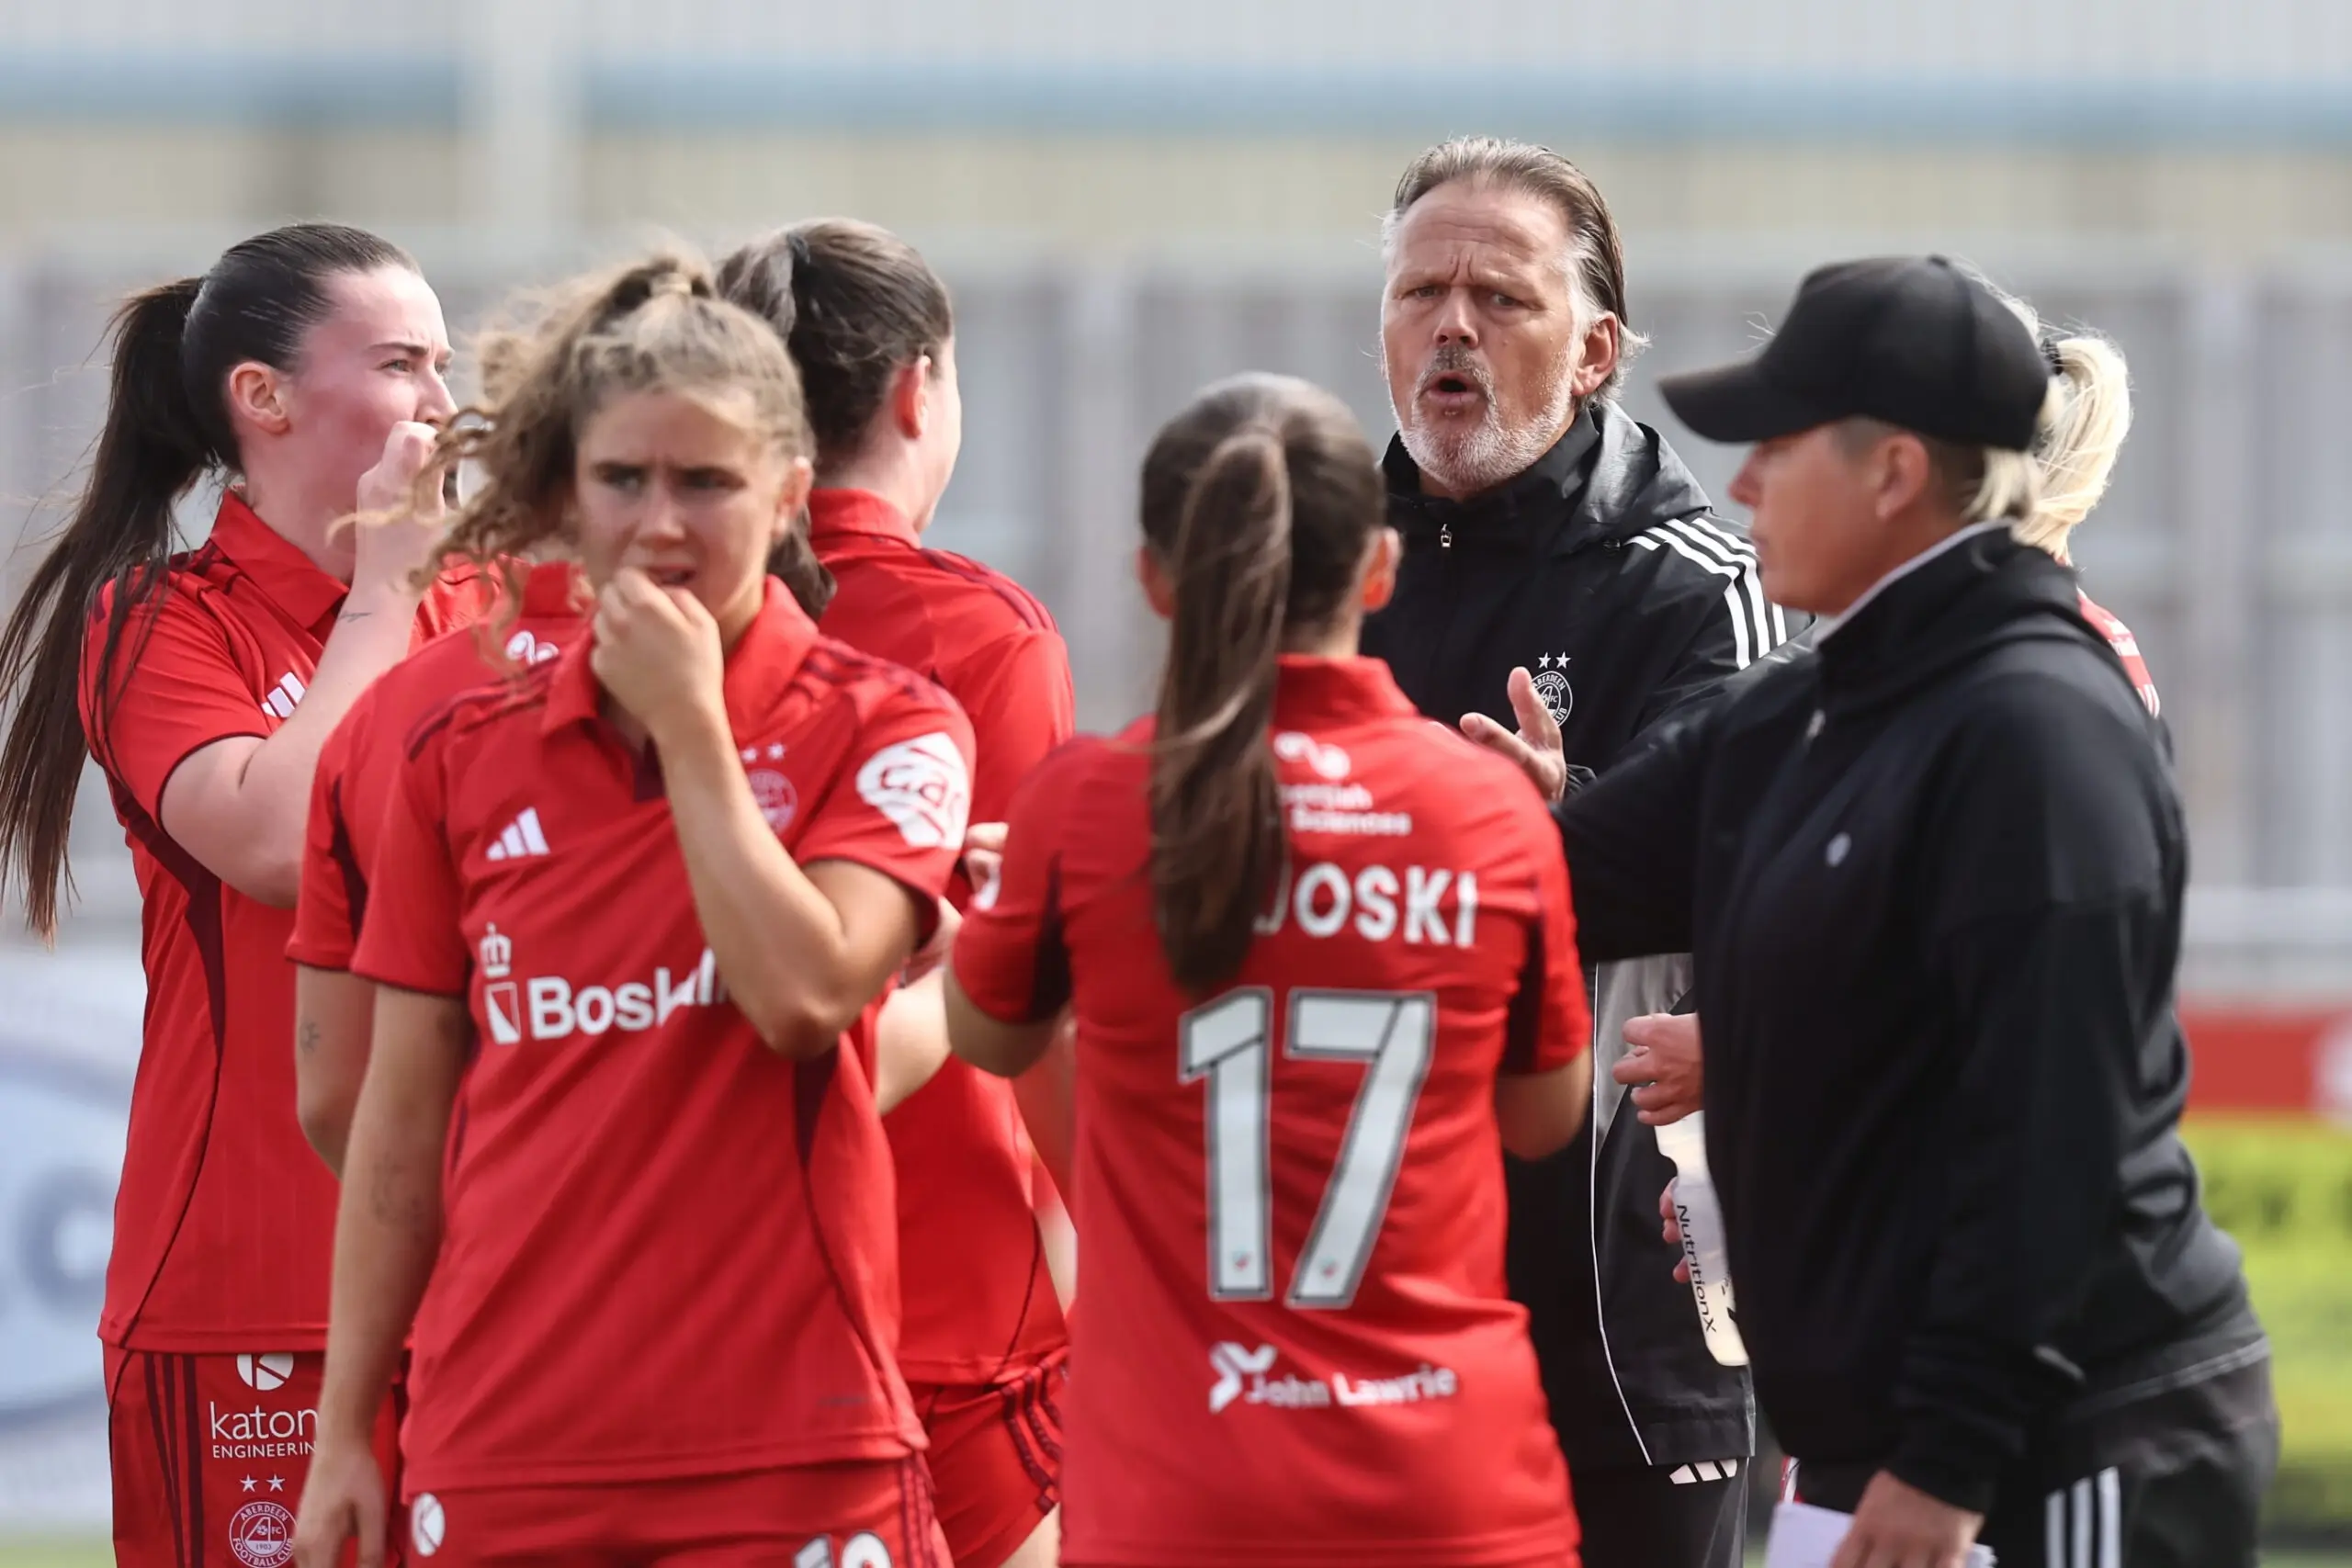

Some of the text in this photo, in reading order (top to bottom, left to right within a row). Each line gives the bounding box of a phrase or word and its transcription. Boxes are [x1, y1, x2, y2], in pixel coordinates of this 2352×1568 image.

[1252, 861, 1478, 949] JOSKI
[1178, 985, 1438, 1309] 17
[209, 1401, 318, 1440] katon
[212, 1441, 317, 1459] ENGINEERIN
[240, 1505, 288, 1522] ABERDEEN
[232, 1538, 277, 1567] FOOTBALL
